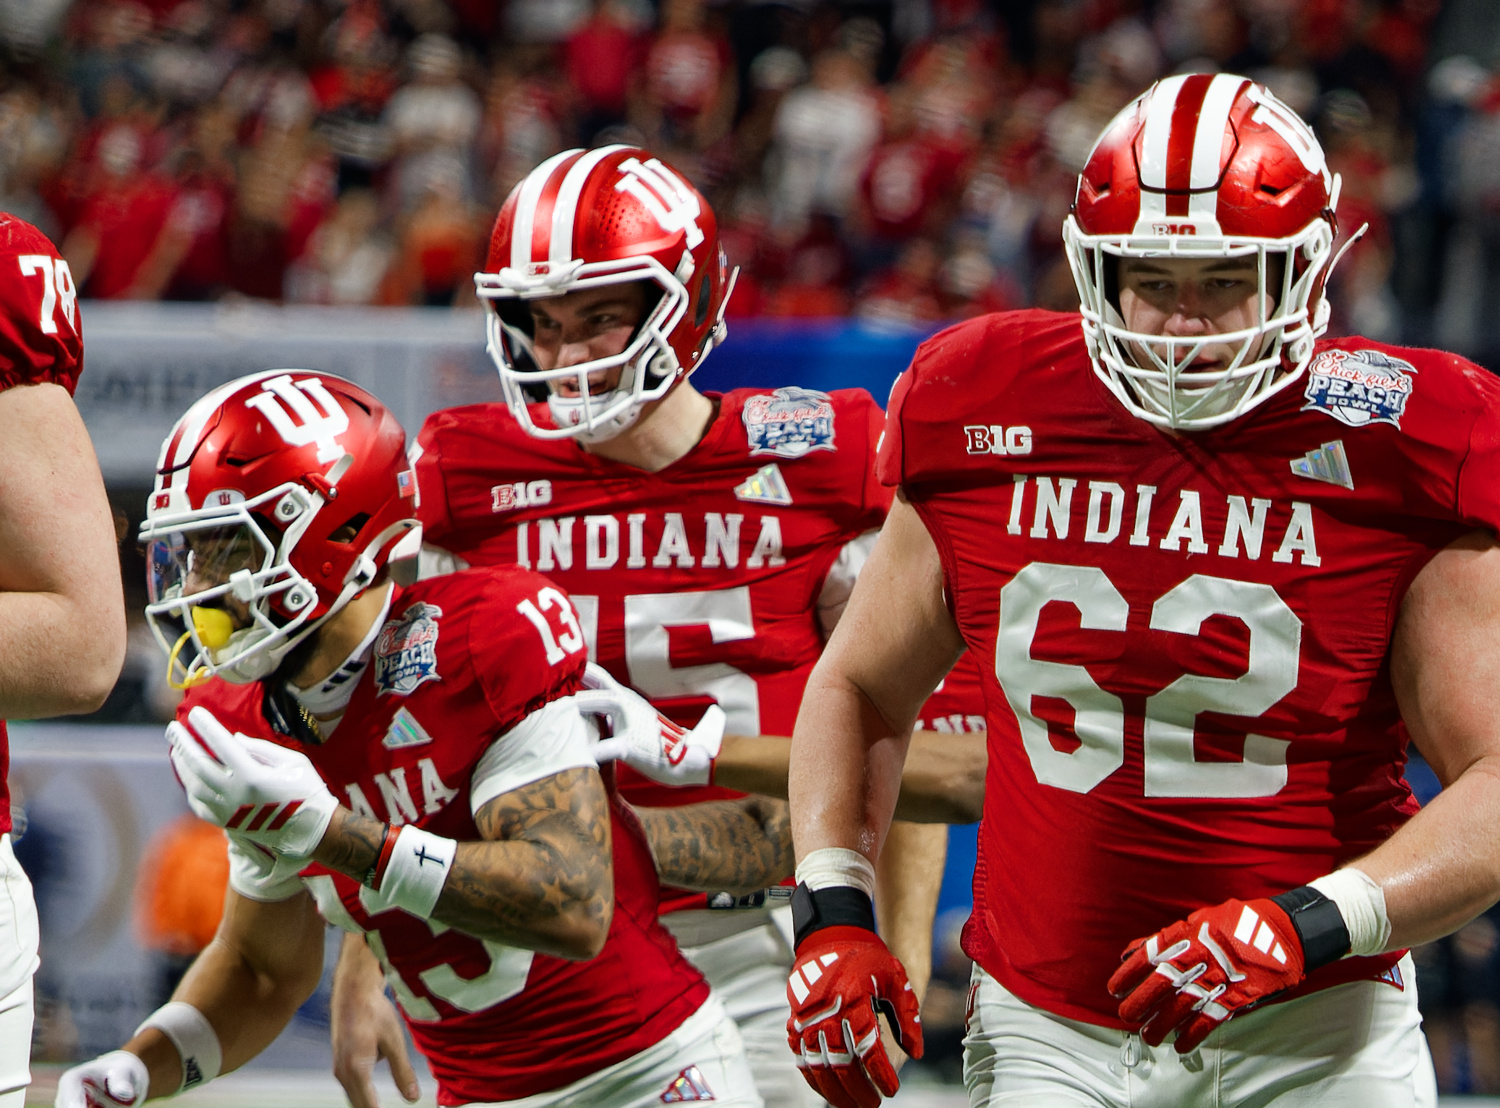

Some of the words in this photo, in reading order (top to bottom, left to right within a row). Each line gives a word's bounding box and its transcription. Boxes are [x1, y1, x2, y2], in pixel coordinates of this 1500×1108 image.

[1309, 376, 1404, 411] PEACH
[1326, 396, 1381, 414] BOWL
[750, 419, 831, 442] PEACH
[516, 512, 788, 571] INDIANA
[1006, 474, 1322, 567] INDIANA
[516, 586, 584, 666] 13
[994, 561, 1303, 799] 62
